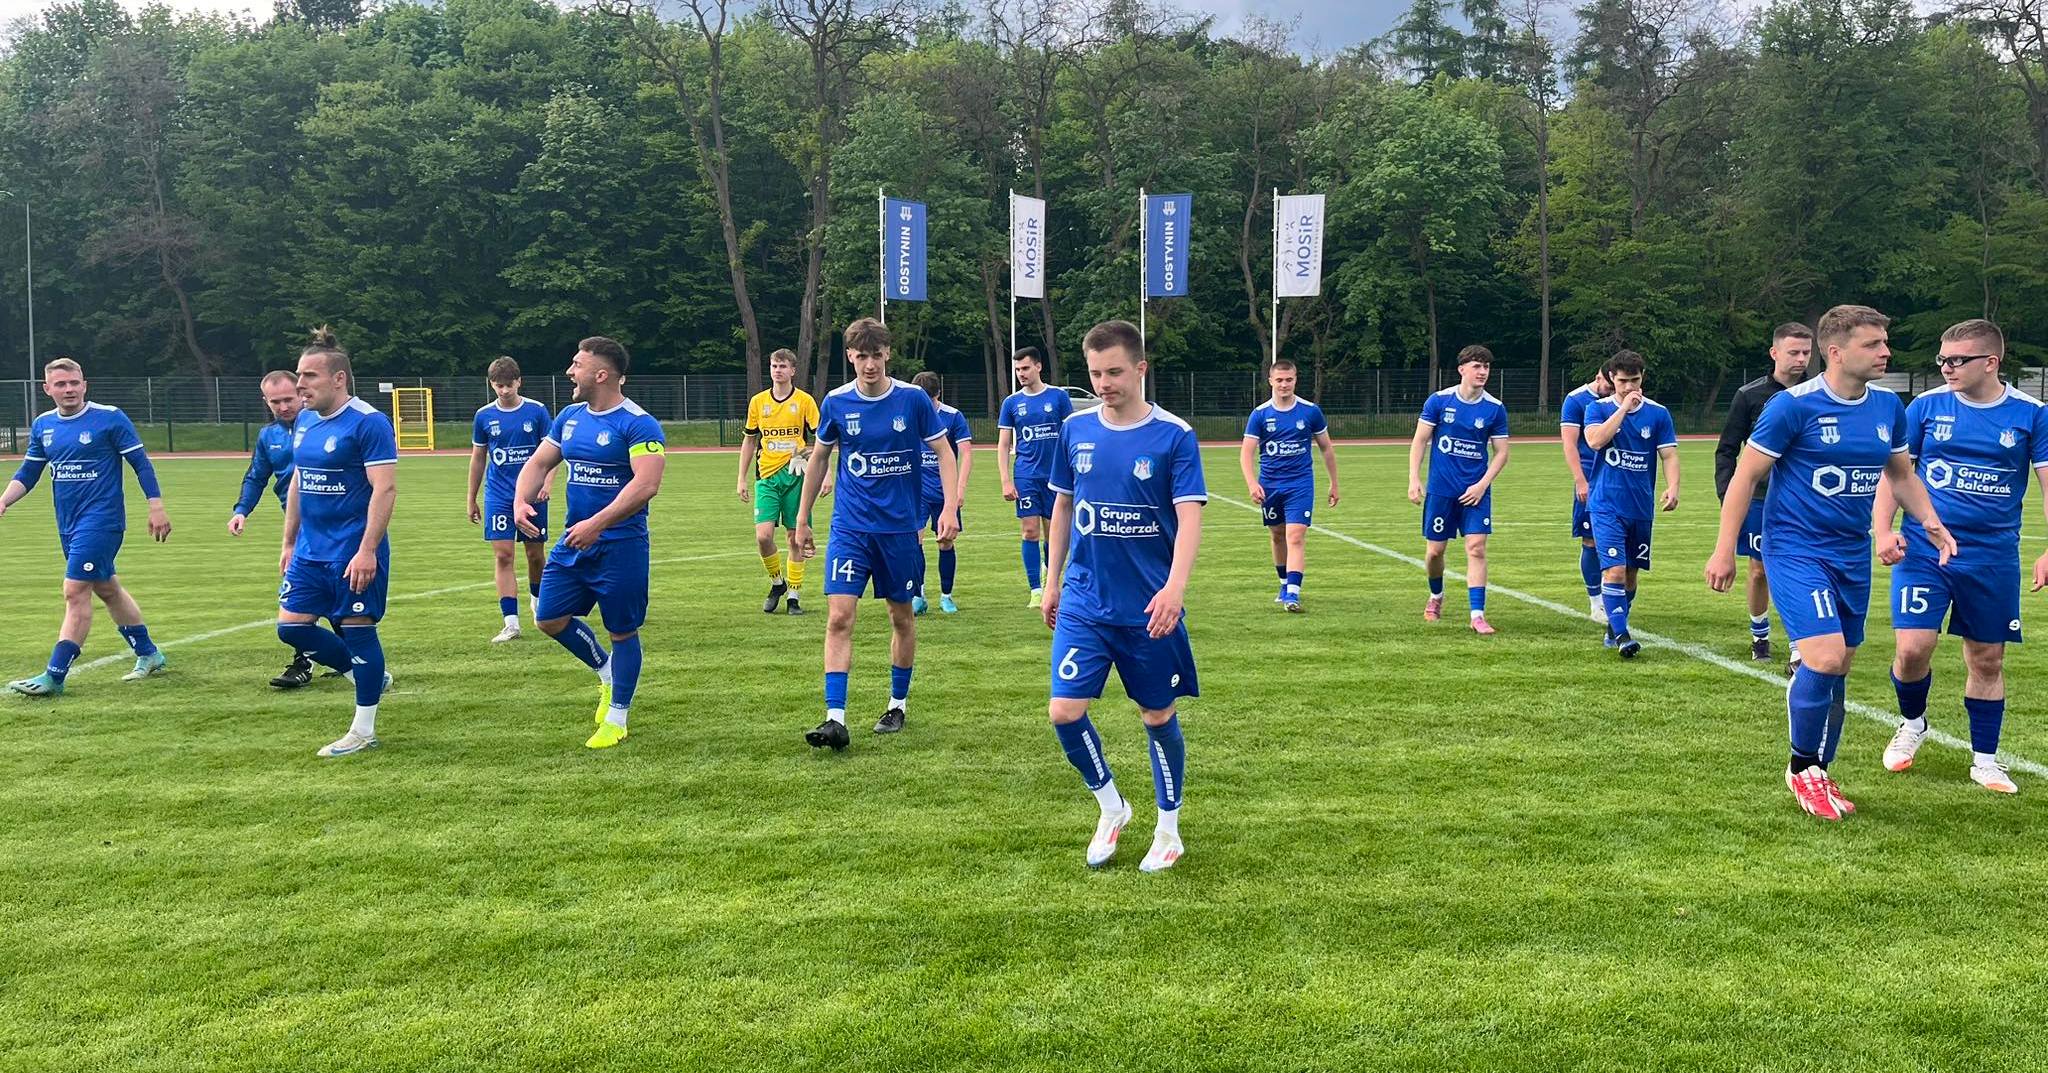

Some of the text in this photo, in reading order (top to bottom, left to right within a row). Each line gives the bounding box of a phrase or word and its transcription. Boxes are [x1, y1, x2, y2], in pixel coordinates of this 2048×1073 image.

[1025, 217, 1038, 279] MOSiR
[1296, 215, 1313, 277] MOSiR
[899, 226, 911, 295] GOSTYNIN
[1164, 221, 1175, 291] GOSTYNIN
[763, 428, 800, 437] DOBER
[1454, 440, 1476, 450] Grupa
[870, 455, 900, 465] Grupa
[921, 452, 938, 460] Grup
[1621, 452, 1644, 463] Grupa
[574, 462, 602, 474] Grupa
[870, 462, 912, 475] Balcerzak
[1958, 467, 1999, 482] Grupa
[302, 470, 327, 483] Grupa
[573, 474, 620, 485] Balcerzak
[1851, 469, 1881, 482] Grup
[302, 481, 346, 492] Balcerzak
[1850, 482, 1877, 493] Balce
[1956, 479, 2012, 494] Balcerzak
[1019, 496, 1032, 510] 13
[1100, 507, 1141, 522] Grupa
[1263, 507, 1278, 519] 16
[491, 514, 508, 531] 18
[1100, 521, 1160, 533] Balcerzak
[1433, 516, 1445, 533] 8
[831, 557, 856, 582] 14
[1811, 589, 1834, 619] 11
[1900, 587, 1930, 614] 15
[1058, 648, 1079, 680] 6
